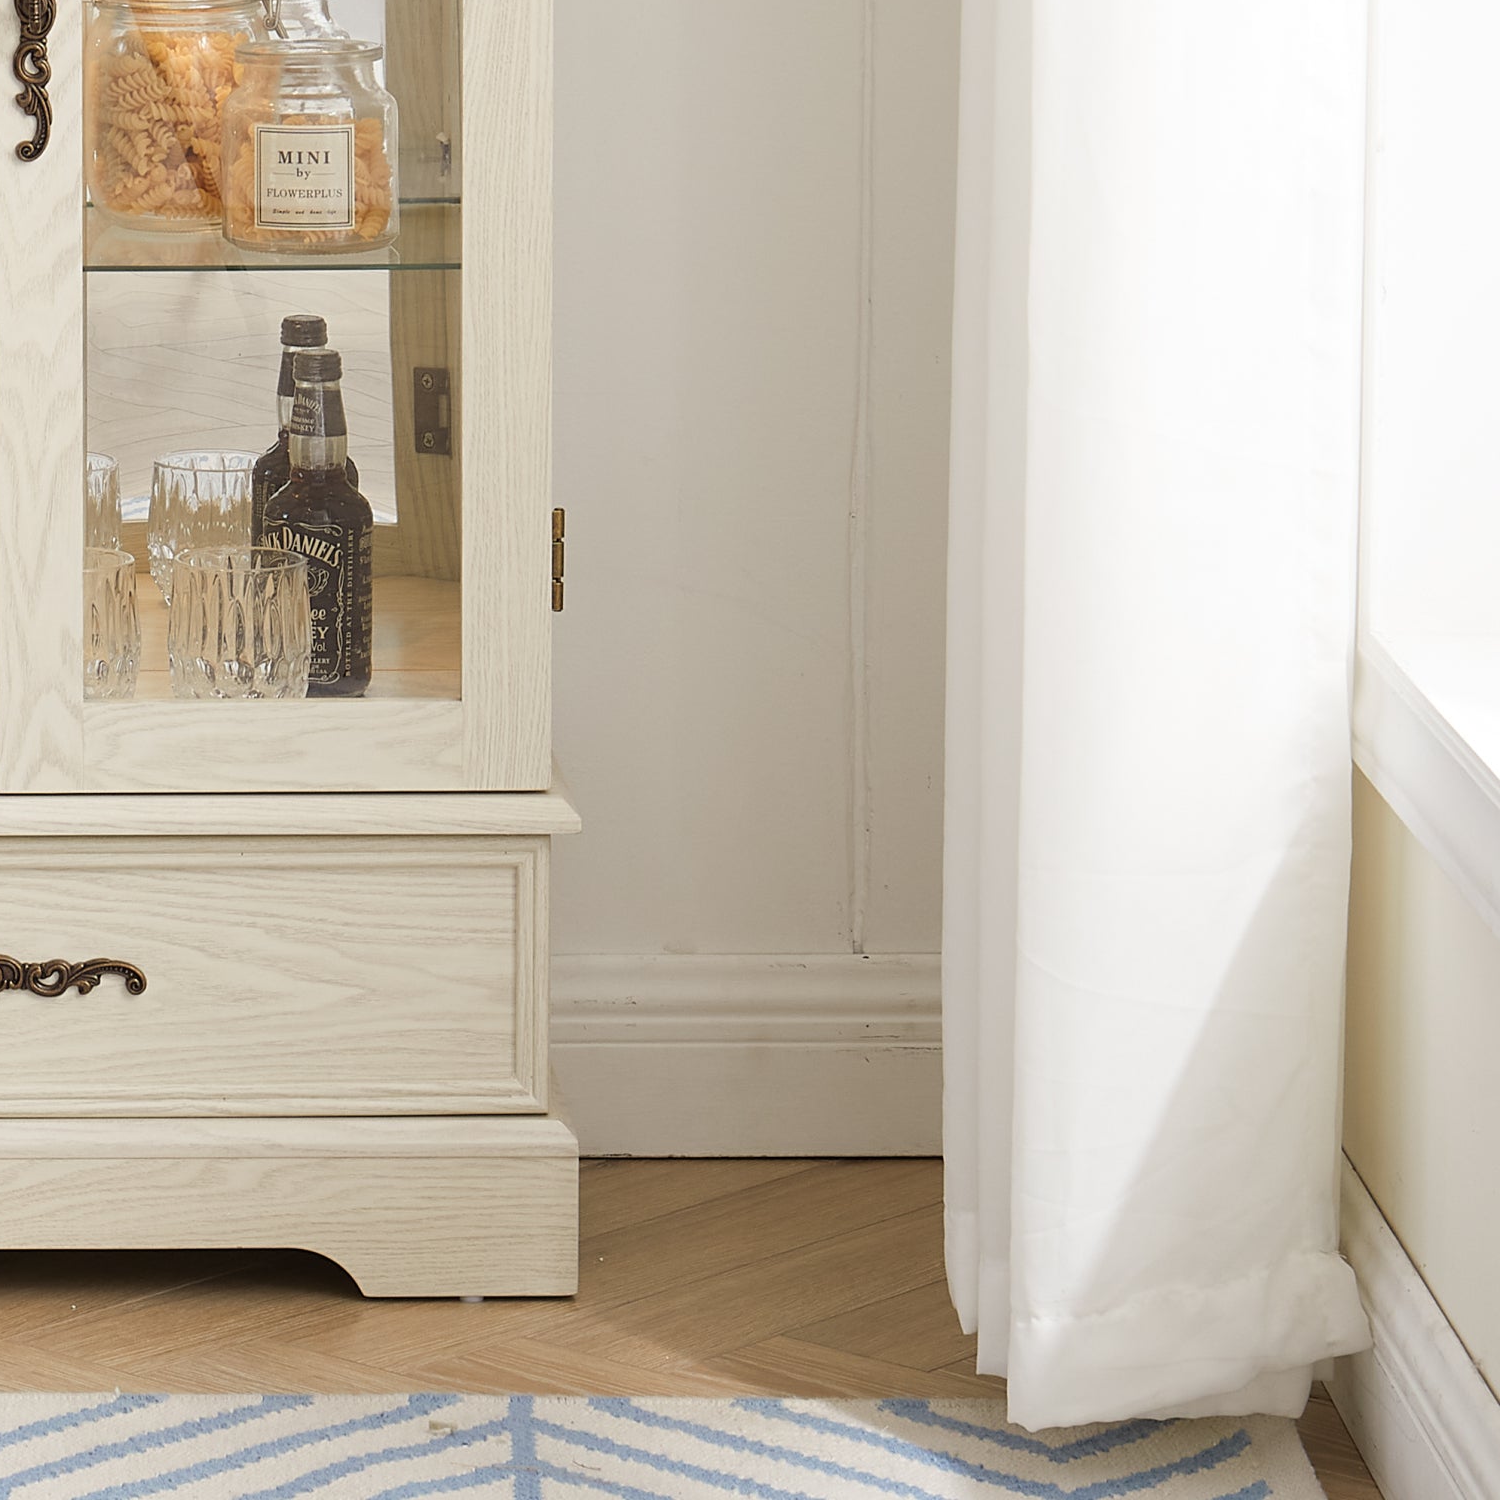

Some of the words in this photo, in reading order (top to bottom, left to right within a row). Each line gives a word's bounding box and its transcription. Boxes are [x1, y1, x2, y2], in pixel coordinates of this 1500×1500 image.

[278, 150, 330, 165] MINI
[296, 167, 311, 180] by
[266, 188, 343, 199] FLOWERPLUS
[346, 615, 352, 628] AT
